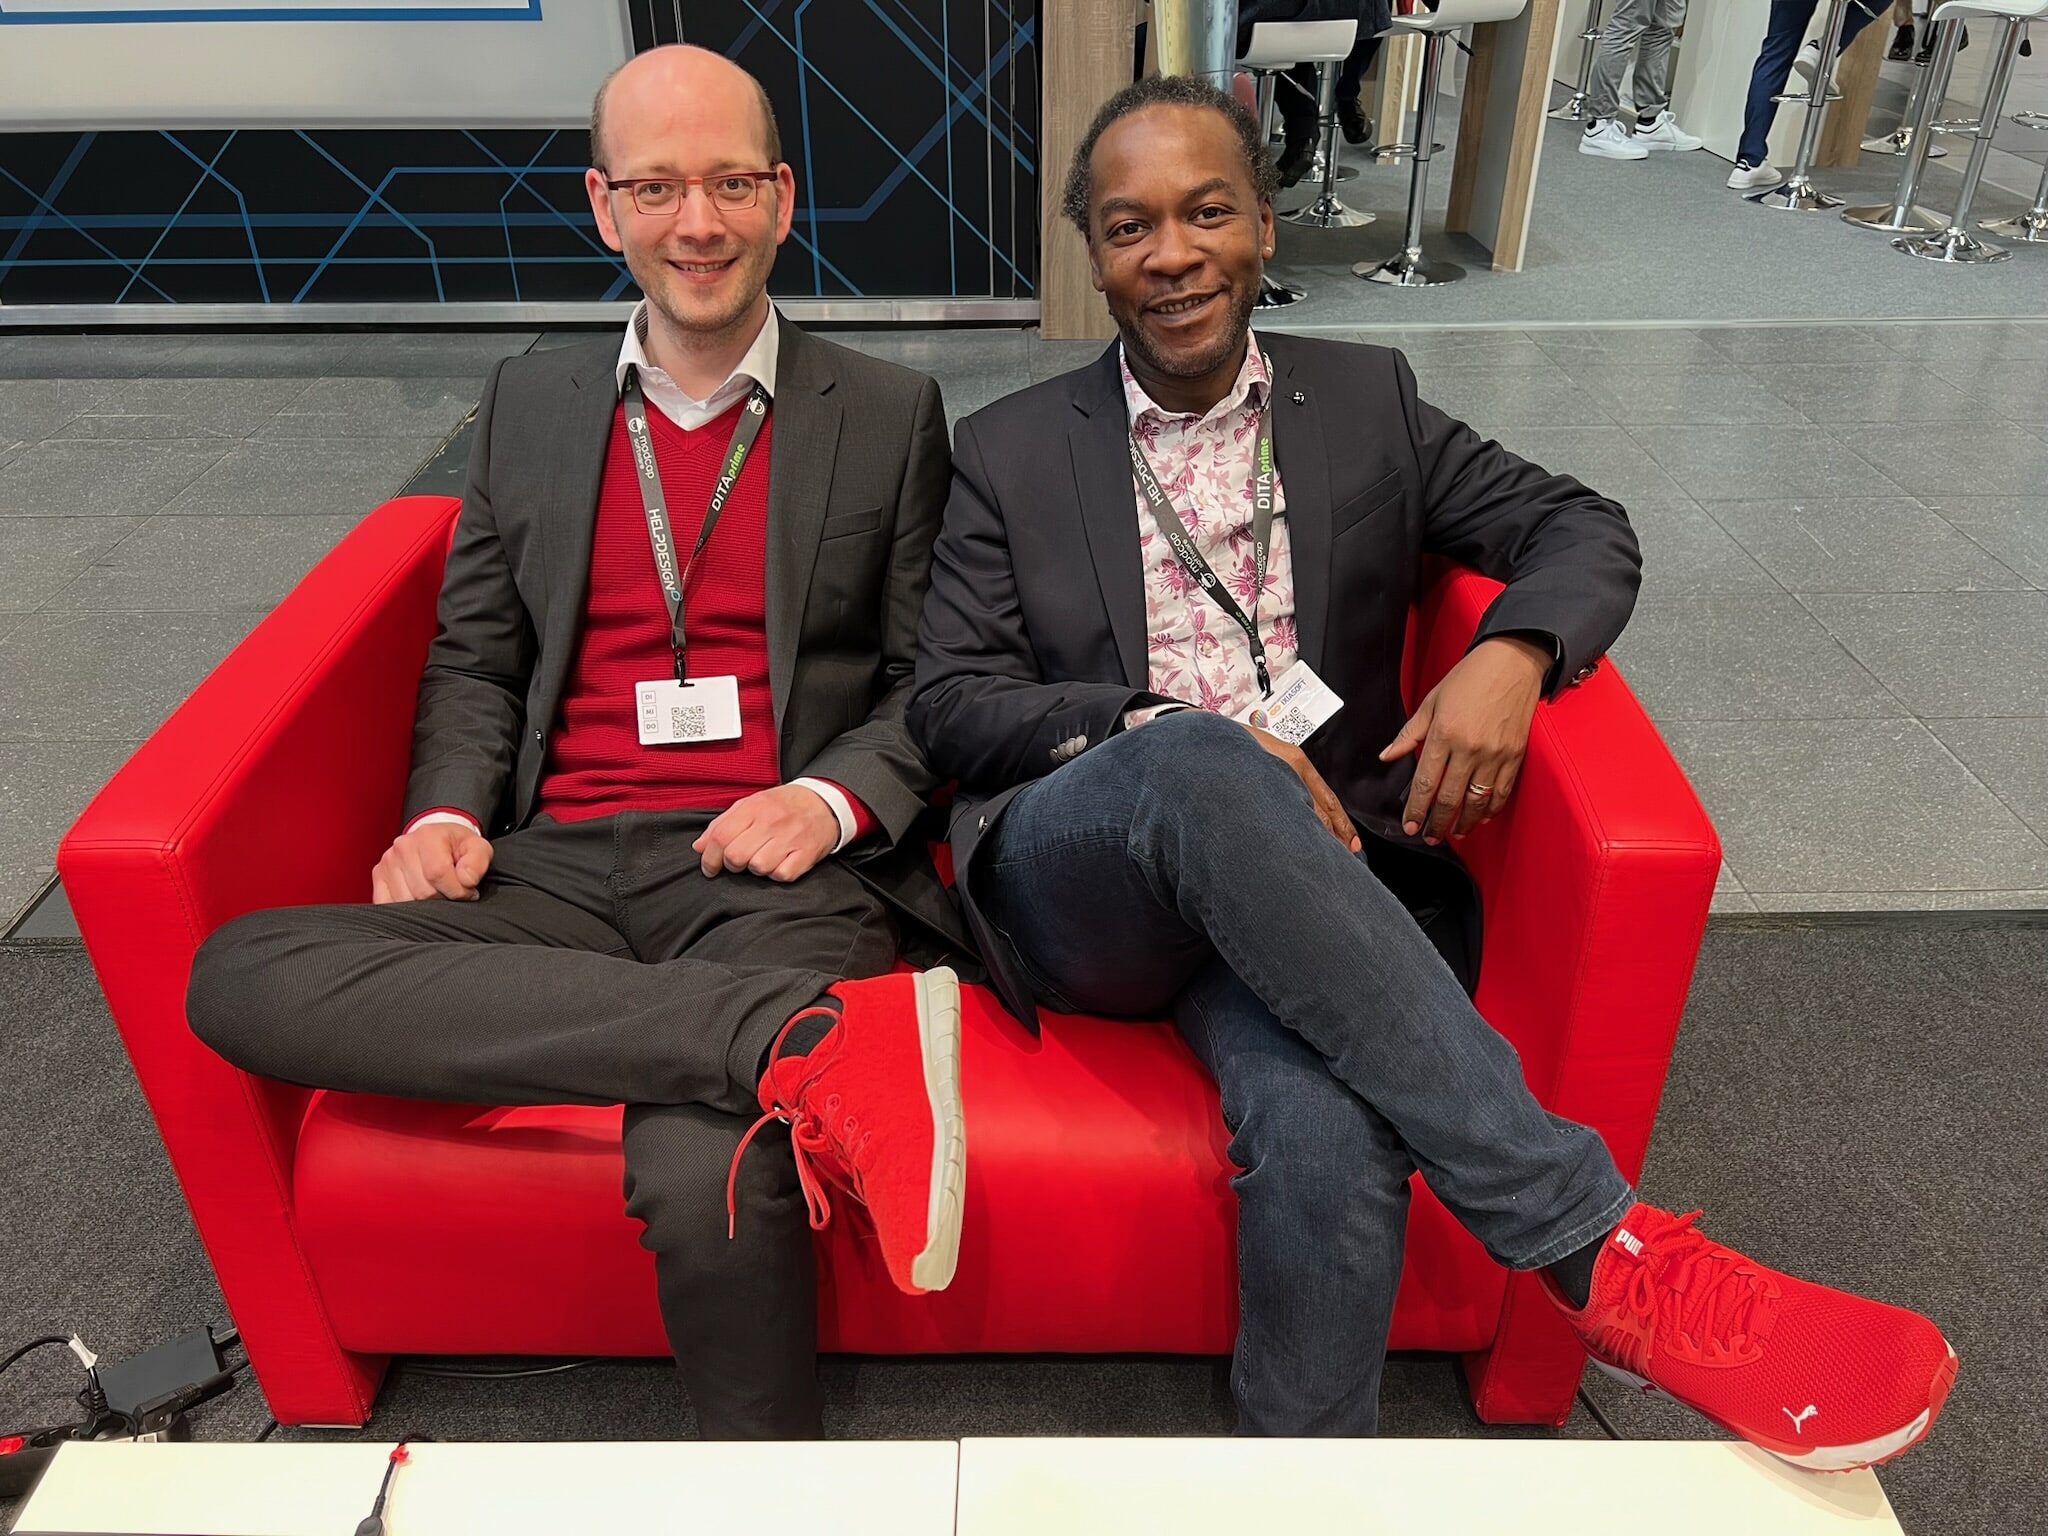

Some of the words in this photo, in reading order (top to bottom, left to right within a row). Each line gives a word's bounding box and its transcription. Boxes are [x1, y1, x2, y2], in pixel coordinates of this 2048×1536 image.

[639, 435, 655, 479] madcap
[1256, 437, 1273, 510] DITAprime
[648, 508, 676, 591] HELPDESIGN
[1170, 532, 1200, 574] madcap
